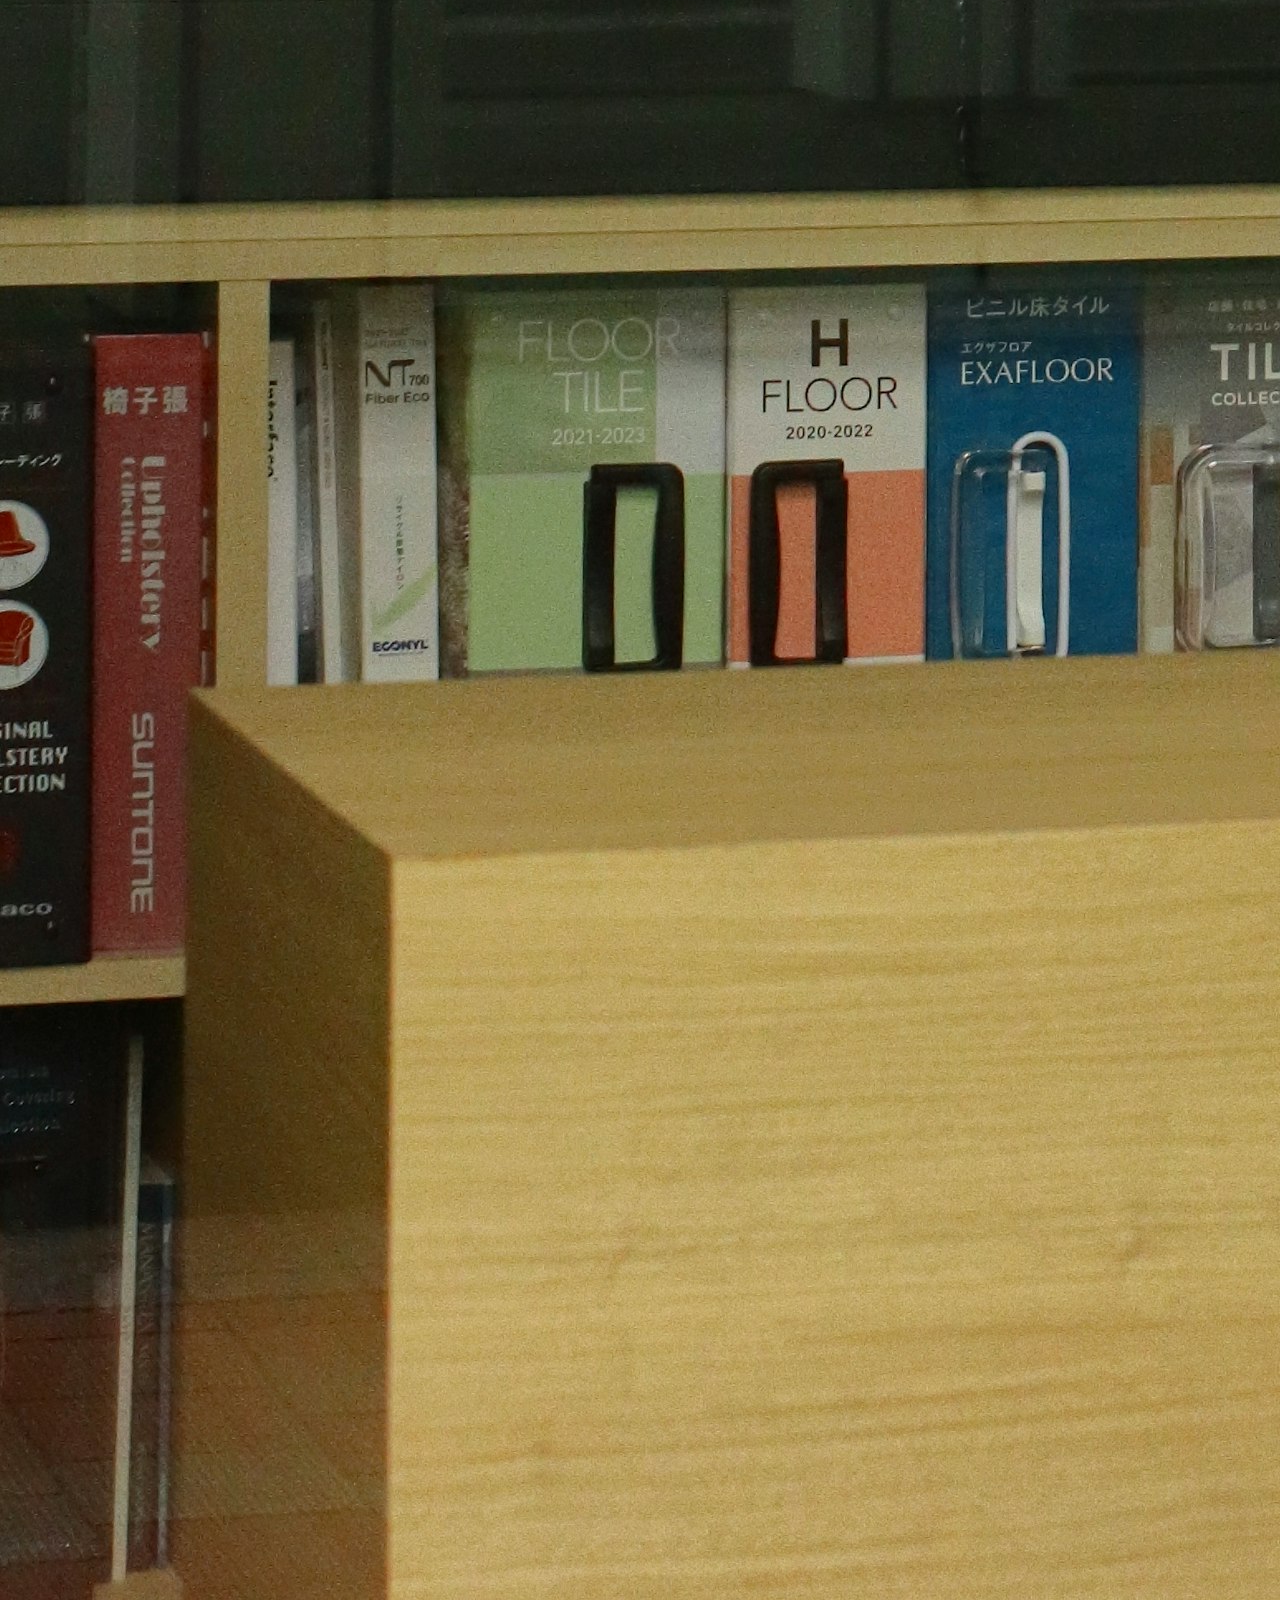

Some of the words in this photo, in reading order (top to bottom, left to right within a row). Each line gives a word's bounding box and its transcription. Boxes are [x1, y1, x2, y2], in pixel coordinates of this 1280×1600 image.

[967, 295, 1110, 318] ビニル床タイル
[518, 316, 682, 362] FLOOR
[810, 318, 849, 367] H
[364, 359, 415, 389] NT
[408, 373, 431, 387] 700
[959, 357, 1114, 387] EXAFLOOR
[102, 386, 189, 415] 椅子張
[364, 390, 400, 406] Fiber
[403, 389, 431, 404] Eco
[552, 370, 646, 415] TILE
[761, 375, 898, 414] FLOOR
[552, 426, 646, 447] 2021-2023
[785, 423, 875, 440] 2020-2022
[140, 455, 167, 651] Upholstery
[372, 639, 430, 652] ECONYL
[129, 710, 156, 915] SUNTONE
